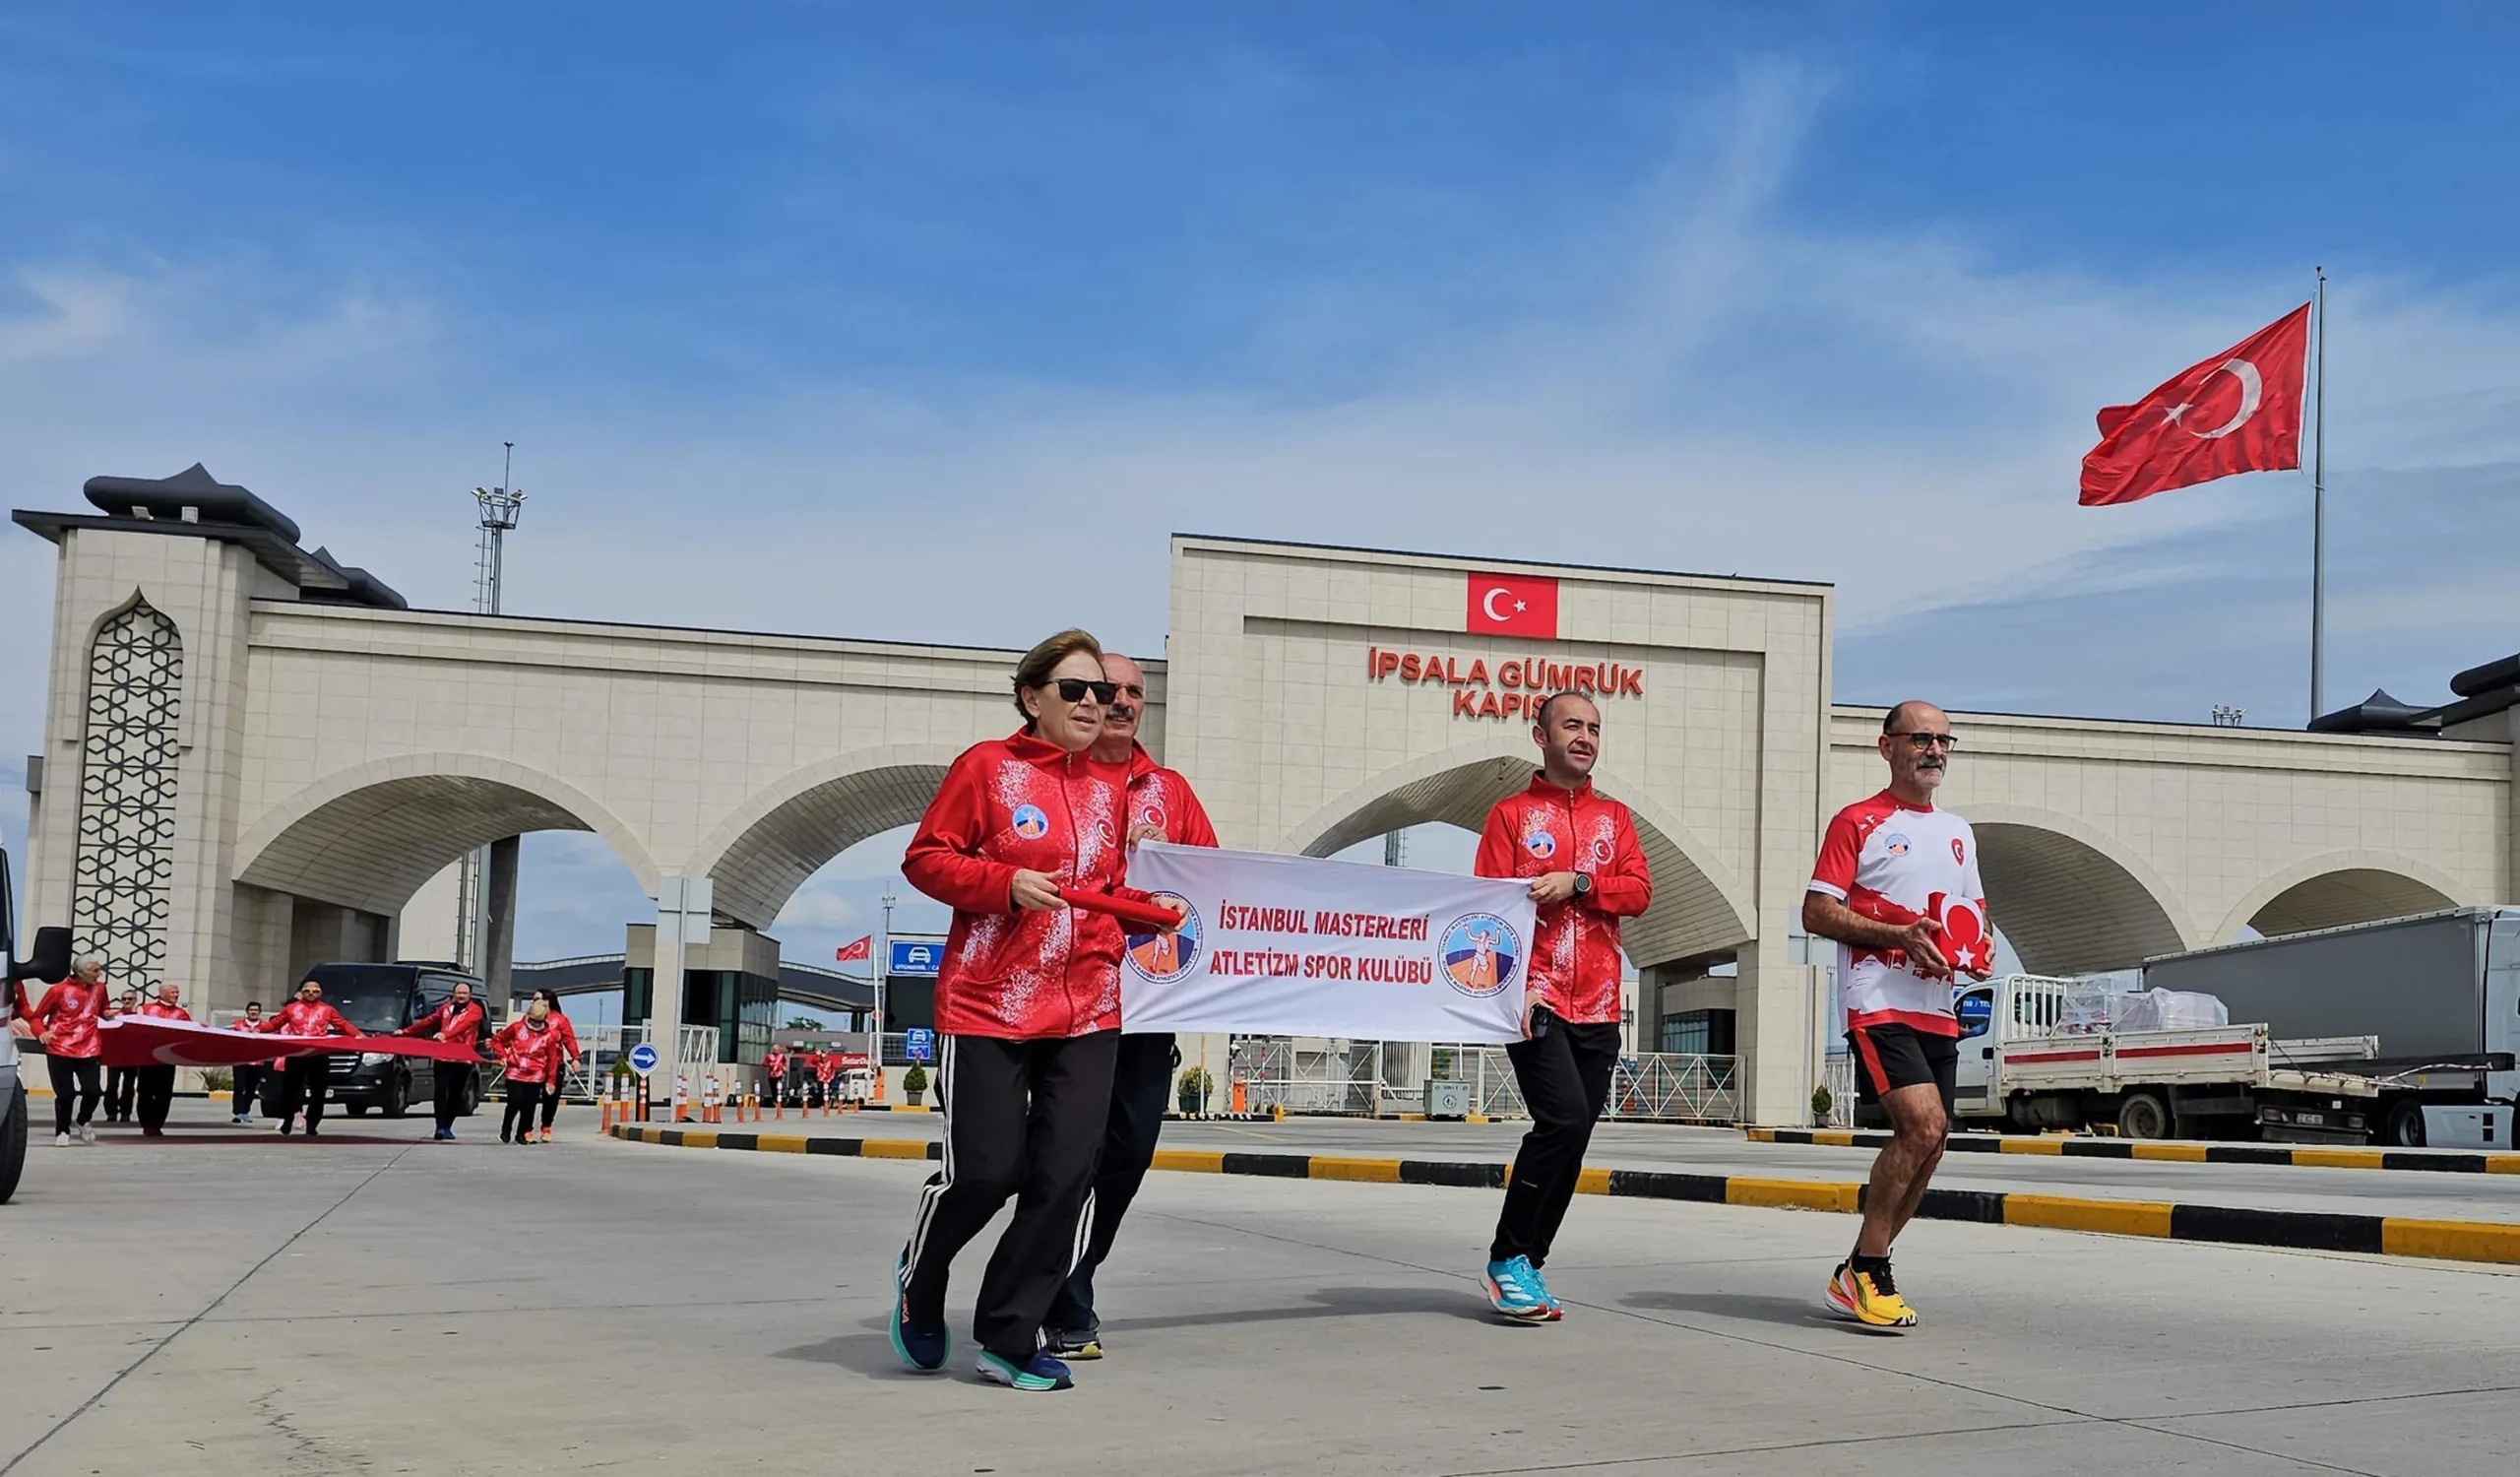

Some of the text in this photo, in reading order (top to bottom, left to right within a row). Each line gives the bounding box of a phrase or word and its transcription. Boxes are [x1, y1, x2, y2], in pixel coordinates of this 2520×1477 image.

[1499, 658, 1643, 695] GÜMRÜK
[1220, 899, 1430, 940] İSTANBUL MASTERLERİ
[1210, 946, 1432, 985] ATLETİZM SPOR KULÜBÜ
